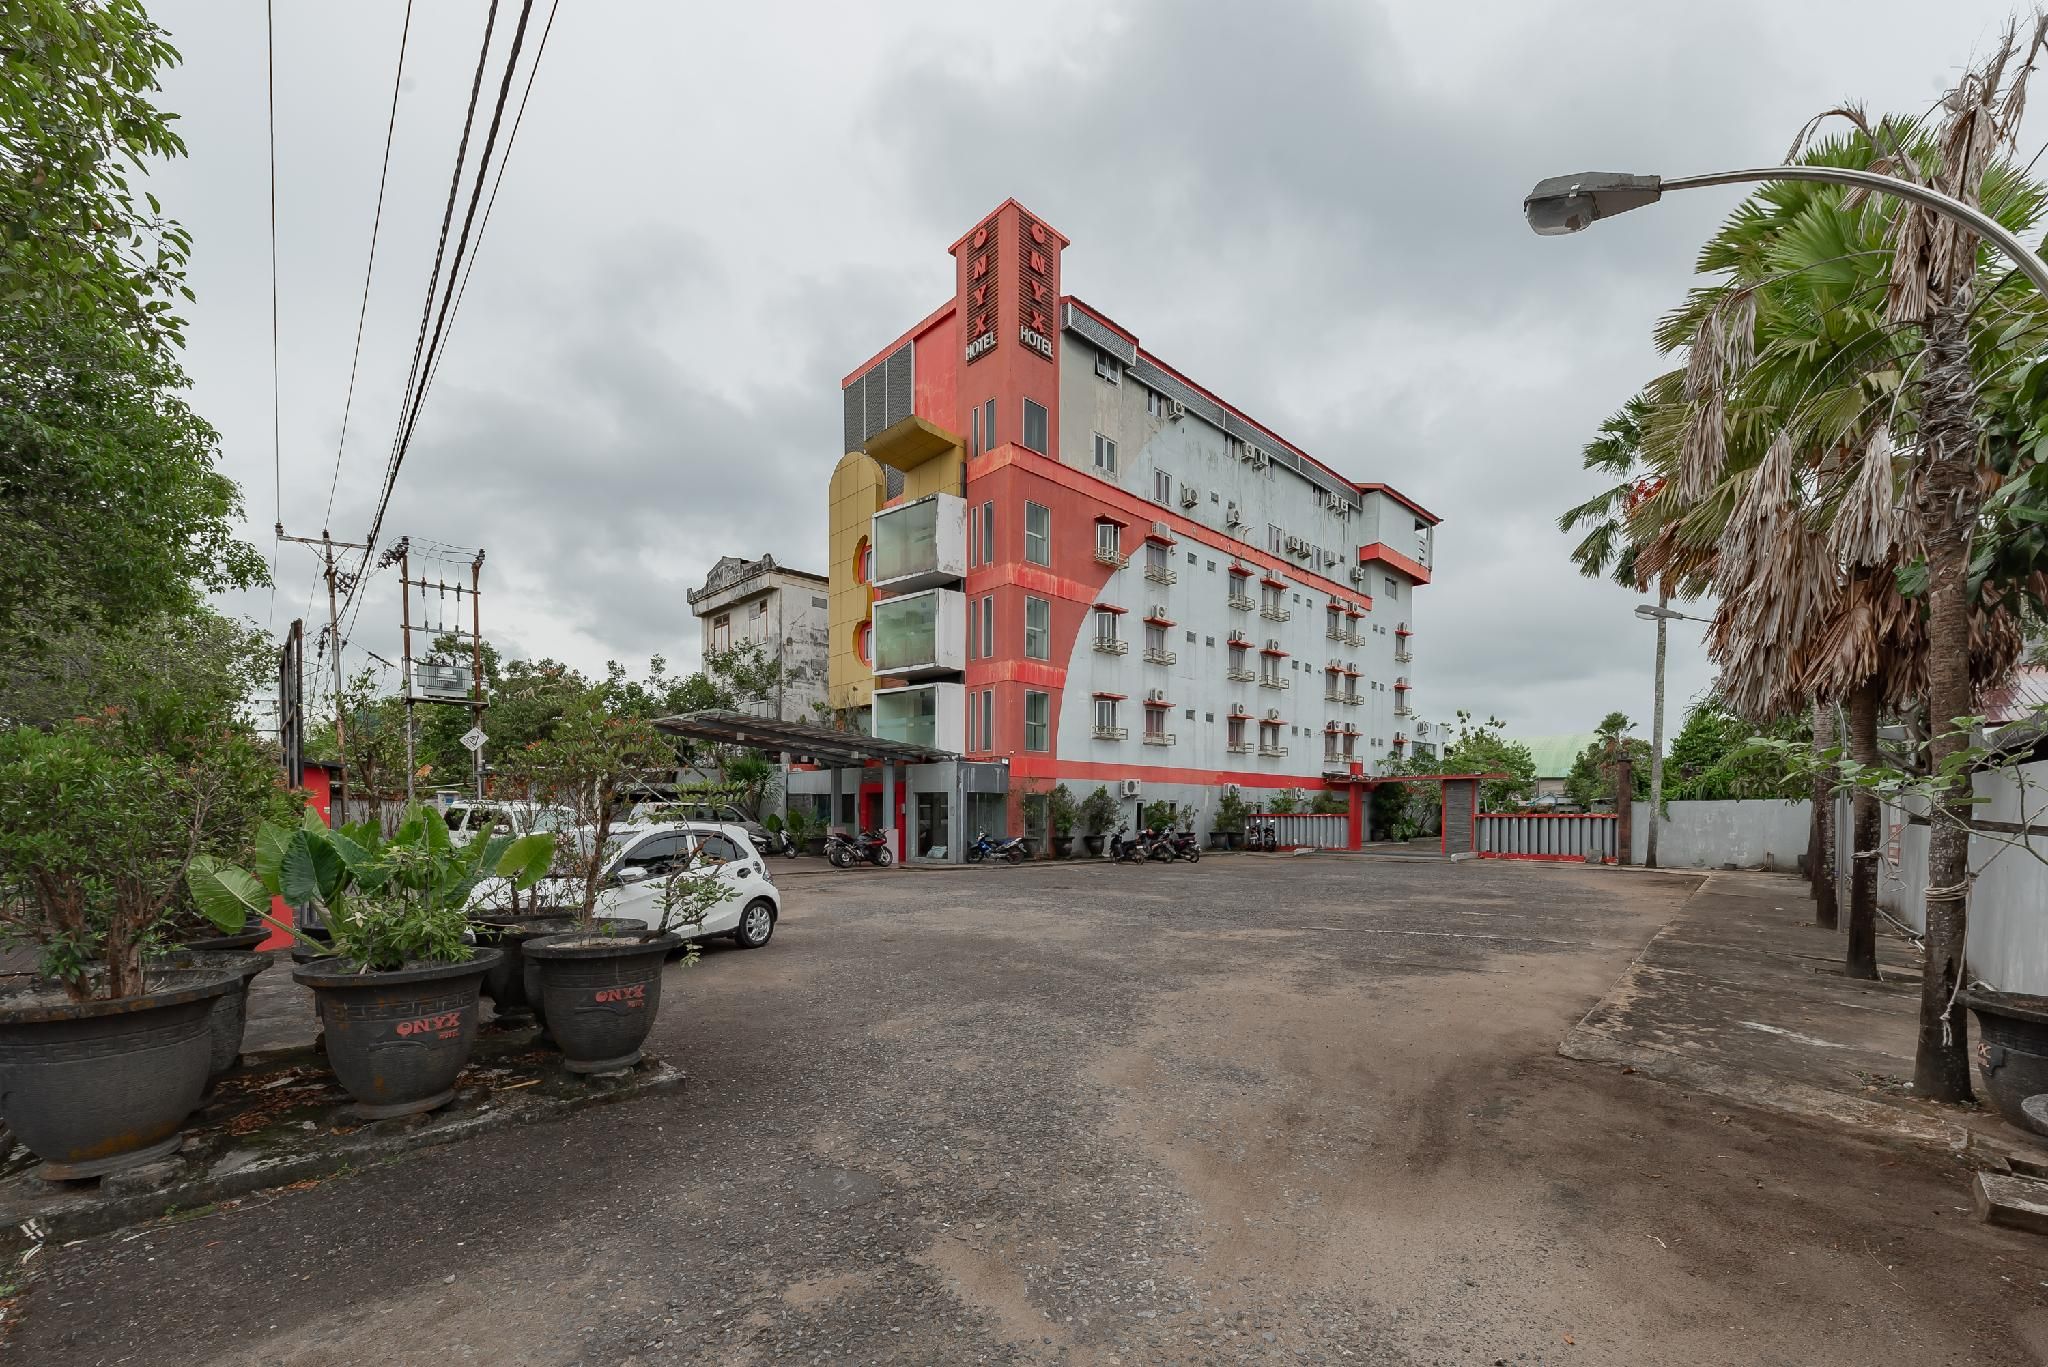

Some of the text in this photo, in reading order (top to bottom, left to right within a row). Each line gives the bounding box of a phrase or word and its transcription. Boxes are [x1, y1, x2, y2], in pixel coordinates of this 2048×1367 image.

[974, 227, 988, 336] ONYX
[1031, 223, 1047, 333] ONYX
[966, 331, 996, 361] HOTEL
[1020, 326, 1053, 358] HOTEL
[595, 985, 645, 1002] ONYX
[396, 1012, 460, 1036] ONYX
